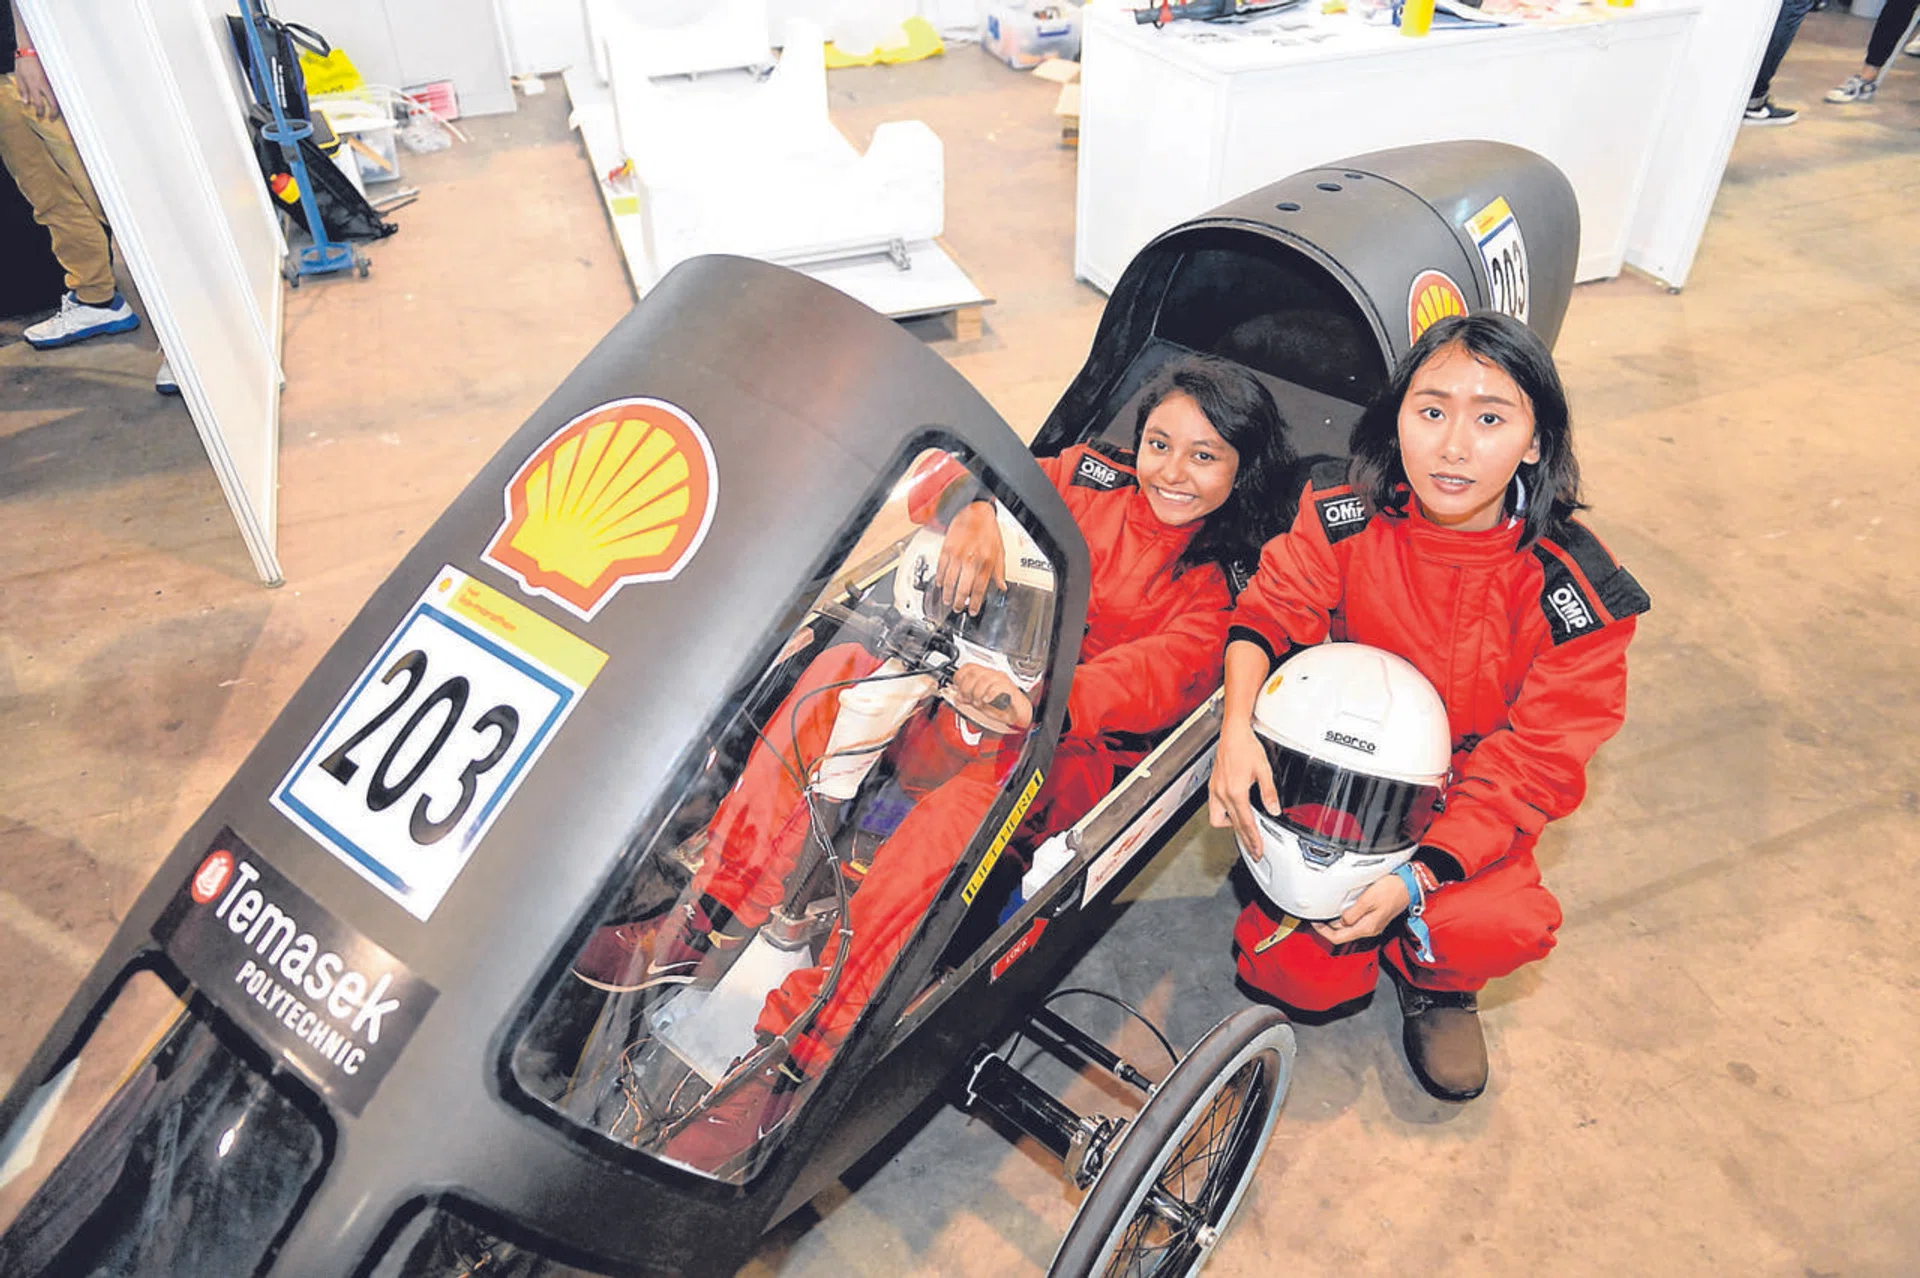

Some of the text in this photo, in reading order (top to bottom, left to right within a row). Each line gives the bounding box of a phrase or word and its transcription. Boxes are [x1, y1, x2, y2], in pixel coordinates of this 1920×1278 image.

[1081, 461, 1116, 483] OMP
[1553, 587, 1588, 628] OMP
[318, 648, 520, 847] 203
[1325, 730, 1376, 753] sparco
[214, 861, 400, 1045] Temasek
[235, 959, 366, 1075] POLYTECHNIC
